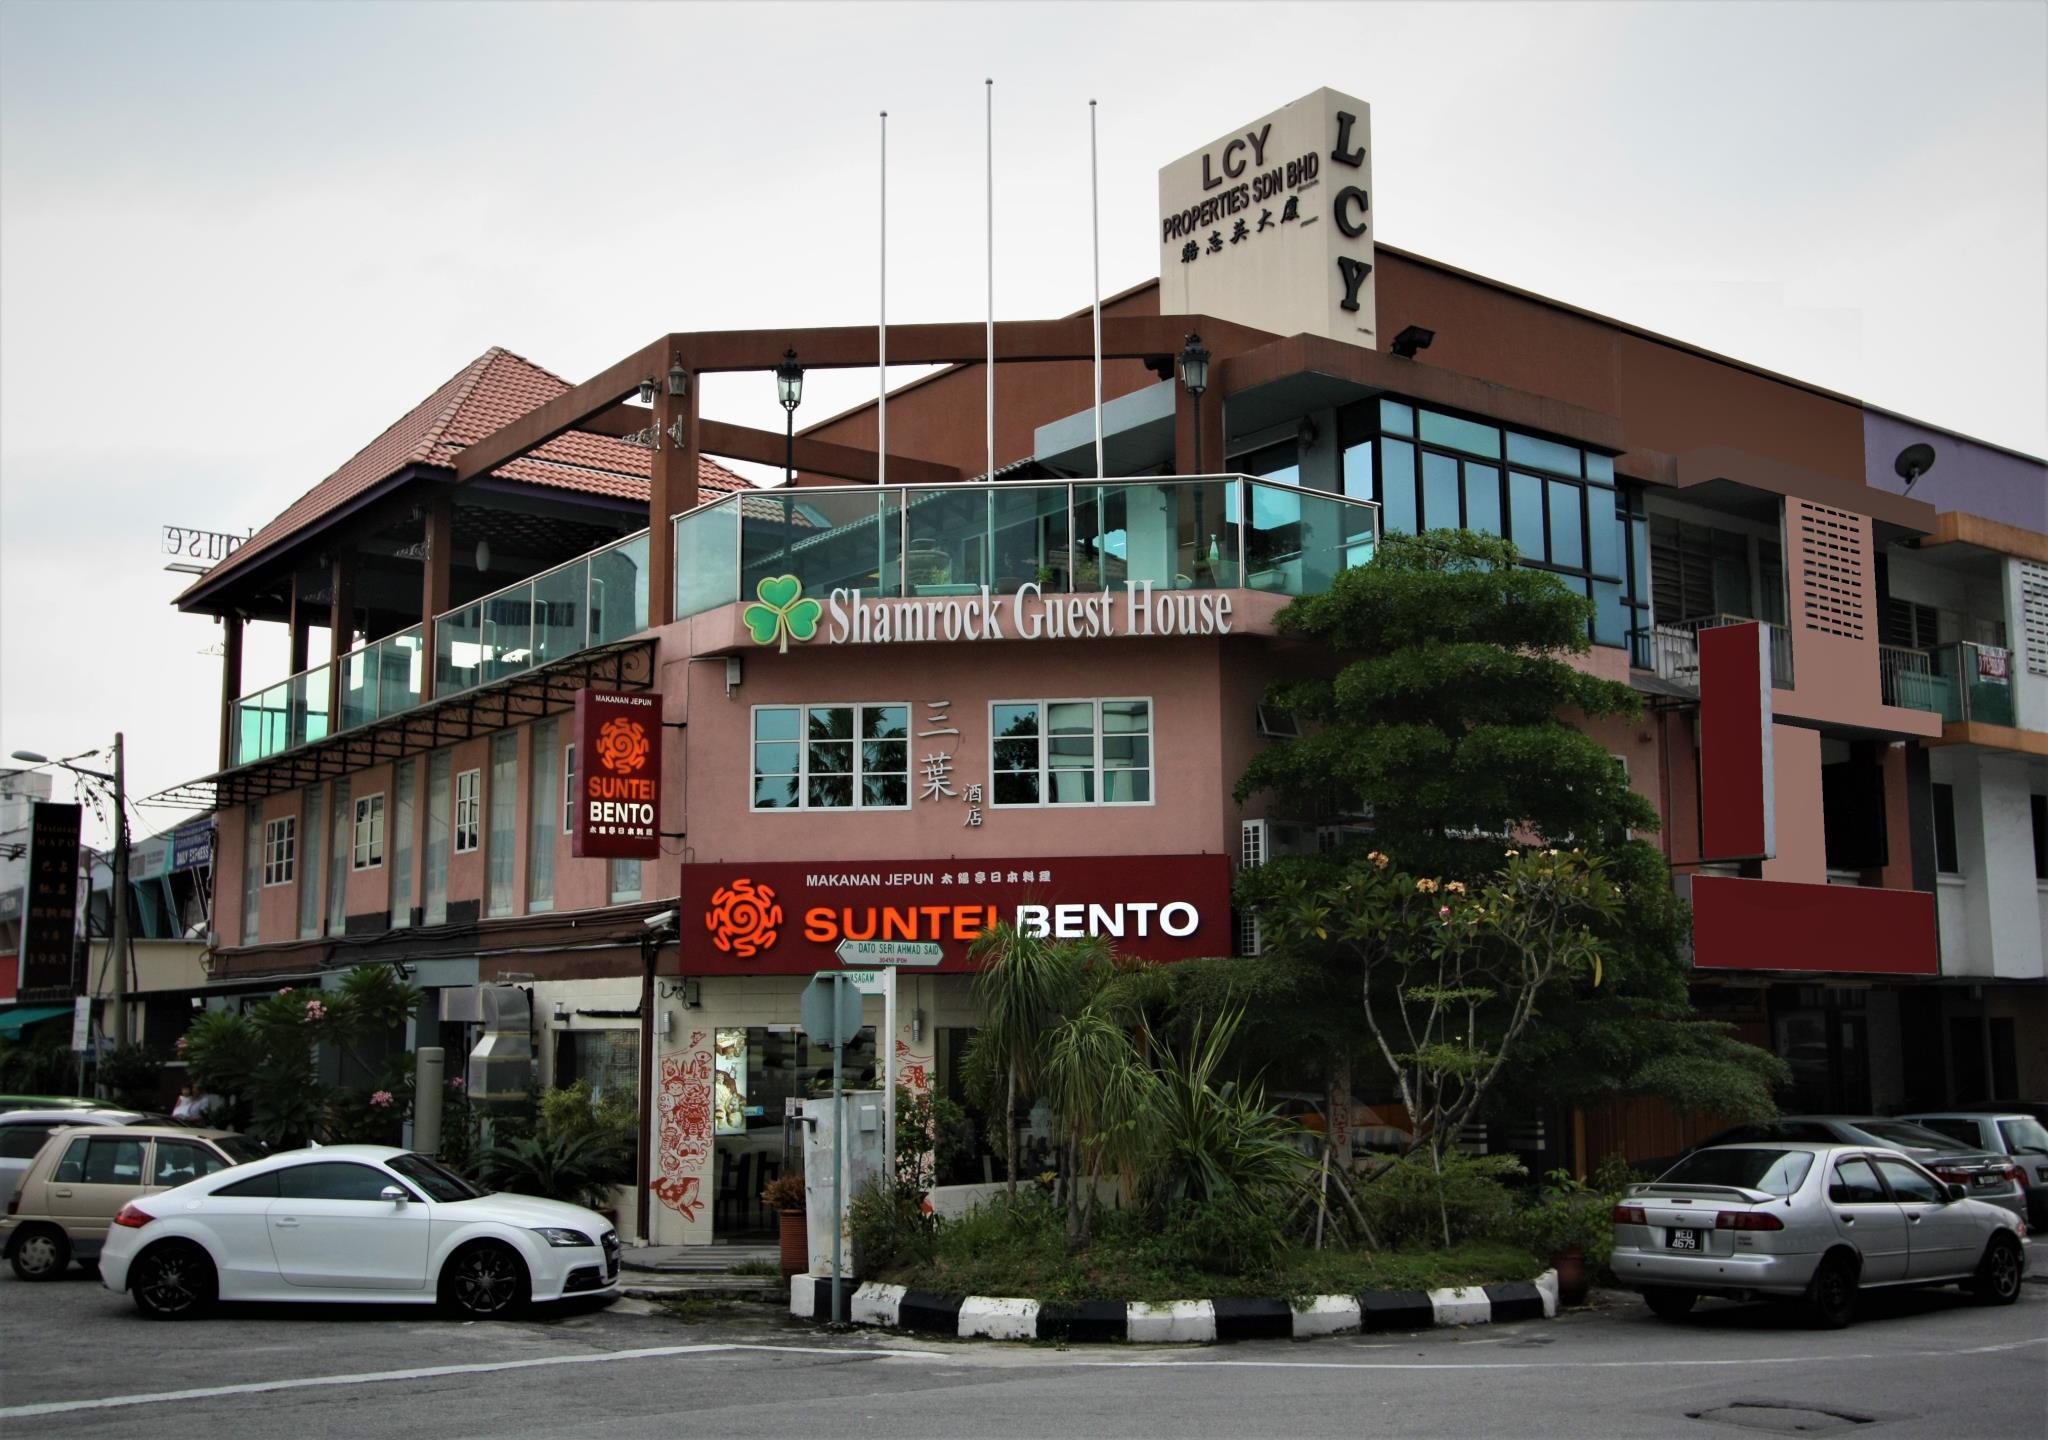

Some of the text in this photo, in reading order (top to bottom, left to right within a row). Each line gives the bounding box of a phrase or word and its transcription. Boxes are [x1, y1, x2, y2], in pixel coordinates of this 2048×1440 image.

[1202, 123, 1272, 191] LCY
[1162, 151, 1319, 243] PROPERTIES SDN BHD
[1331, 110, 1373, 312] LCY
[829, 579, 1233, 645] Shamrock Guest House
[595, 694, 652, 707] MAKANAN JEPUN
[917, 701, 959, 802] 三葉
[588, 776, 655, 800] SUNTEI
[962, 783, 982, 827] 酒店
[590, 801, 654, 824] BENTO
[806, 873, 880, 887] MAKANAN
[885, 872, 934, 886] JEPUN
[804, 901, 1200, 942] SUNTEI BENTO
[858, 942, 876, 954] DATO
[879, 943, 895, 954] SERI
[897, 943, 921, 955] AHMAD
[924, 944, 939, 955] SAID
[1672, 1238, 1696, 1249] 4679
